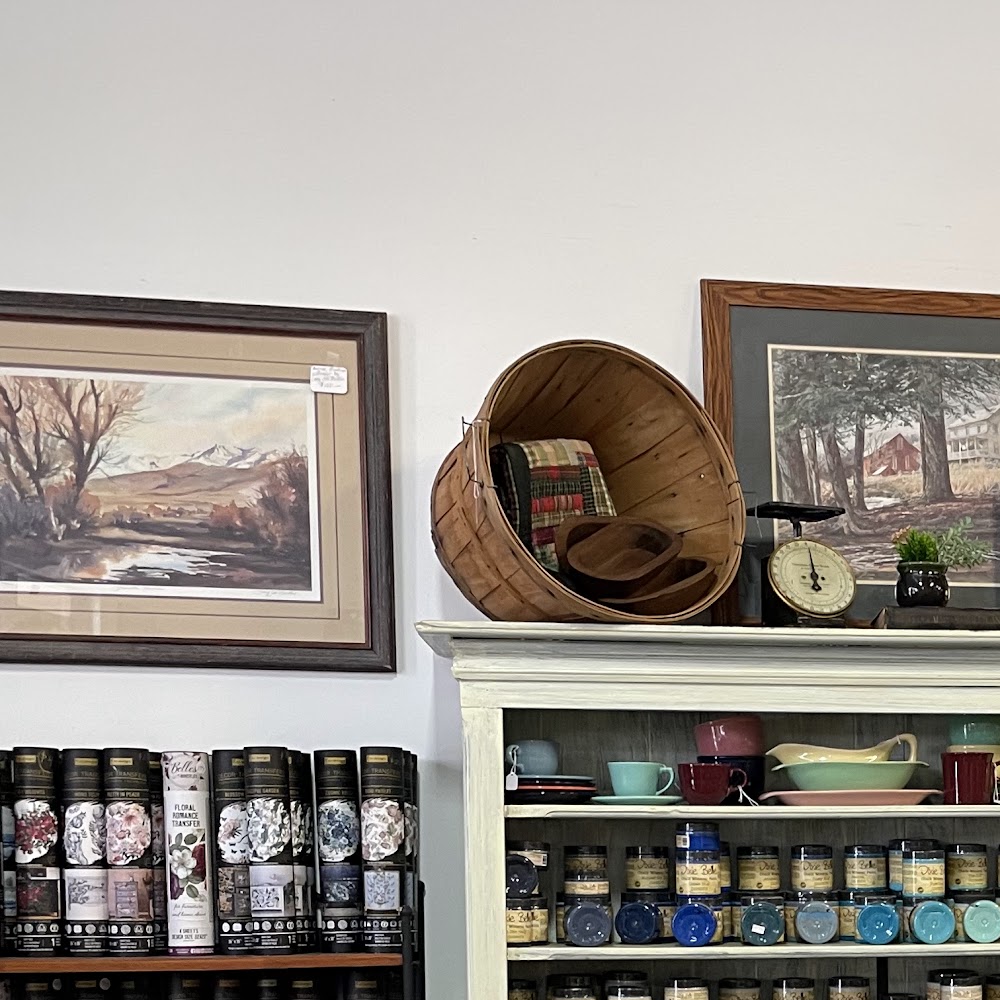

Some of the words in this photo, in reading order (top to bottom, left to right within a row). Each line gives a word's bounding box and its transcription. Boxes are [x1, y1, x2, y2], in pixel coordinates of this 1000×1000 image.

[171, 759, 198, 775] Belles
[804, 861, 820, 871] Dixie
[958, 858, 977, 868] Dixie
[680, 866, 698, 875] Dixie
[701, 866, 718, 875] Belle
[920, 867, 938, 876] Dixie
